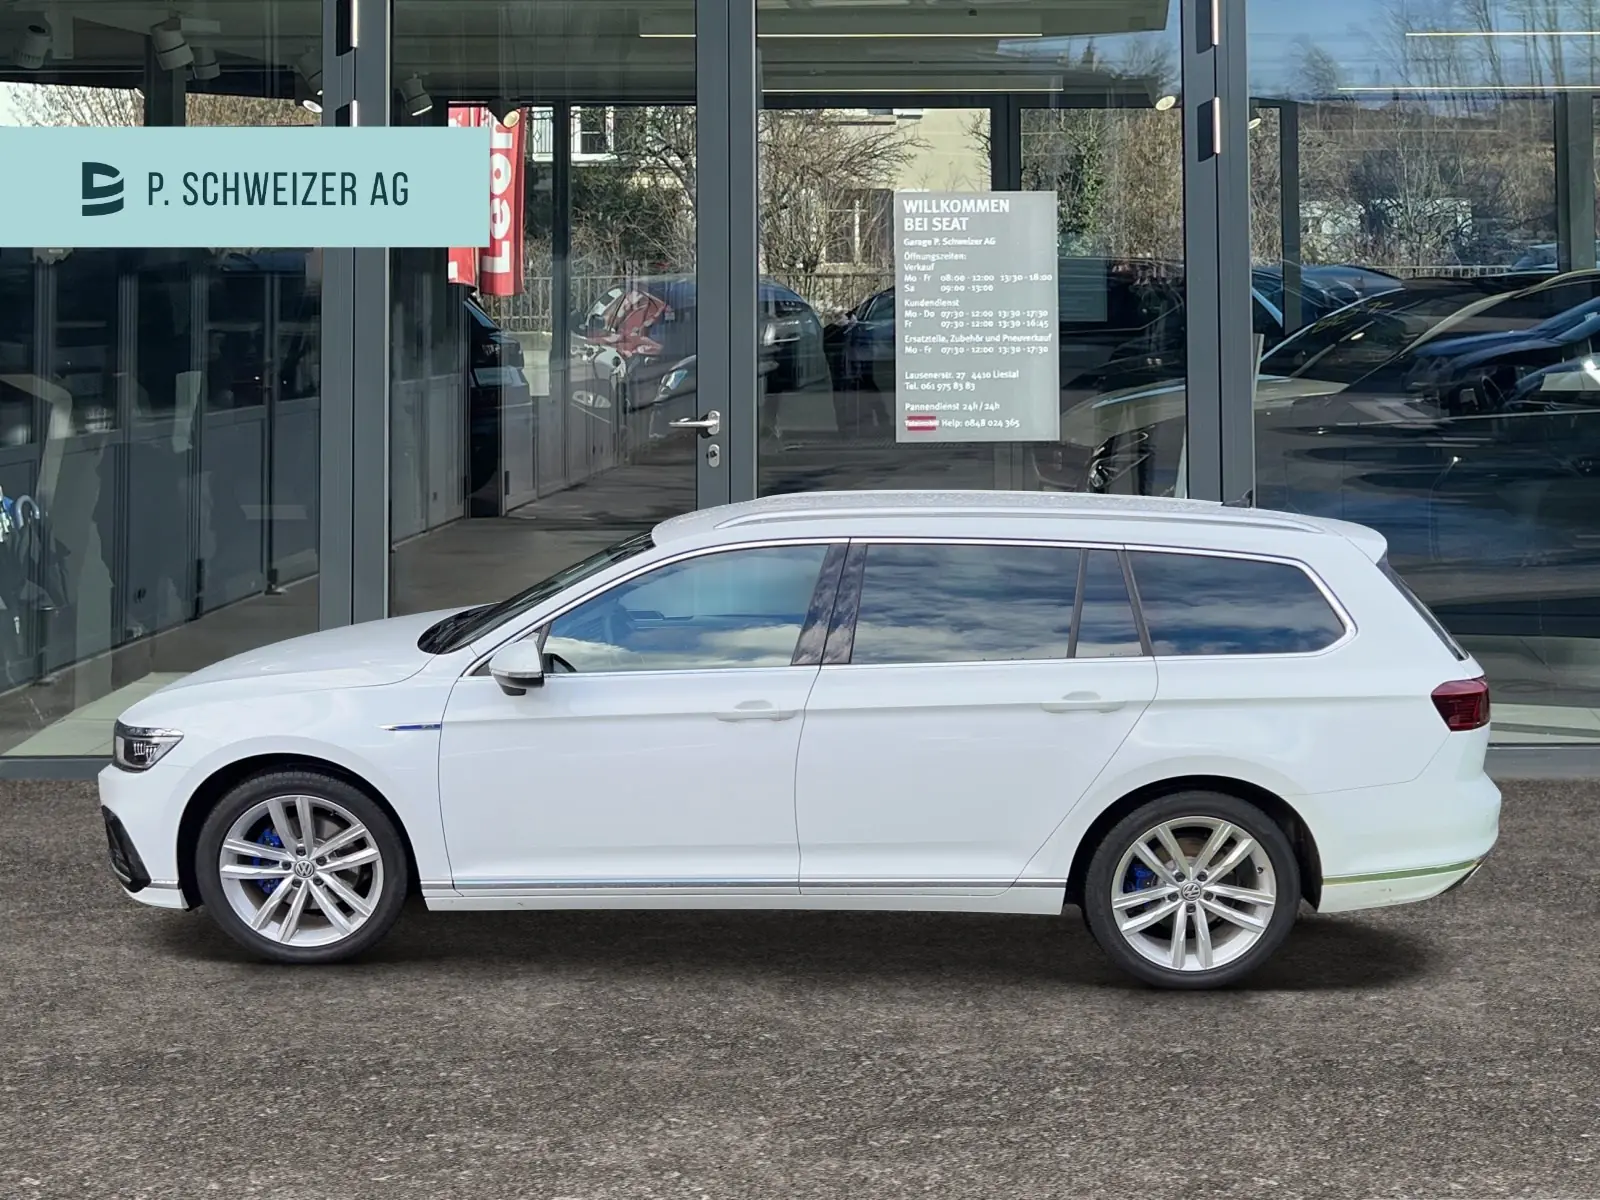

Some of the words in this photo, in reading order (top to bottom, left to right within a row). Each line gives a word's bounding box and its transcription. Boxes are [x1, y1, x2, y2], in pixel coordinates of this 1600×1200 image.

[903, 200, 1010, 213] WILLKOMMEN
[904, 218, 928, 231] BEI
[932, 217, 969, 231] SEAT
[904, 238, 932, 247] Garage
[984, 237, 996, 245] AG
[904, 263, 935, 271] Verkauf
[904, 310, 917, 318] Mo
[924, 310, 935, 318] Do
[941, 311, 964, 320] 07:30
[1027, 310, 1048, 319] 17:30
[1027, 320, 1049, 328] 16:45
[950, 334, 984, 343] Zubehör
[941, 347, 964, 355] 07:30
[956, 372, 966, 380] 27
[993, 370, 1019, 378] Liestal
[905, 382, 918, 390] Tel.
[921, 382, 935, 390] 061
[937, 383, 951, 392] 975
[953, 382, 963, 391] 83
[965, 382, 976, 391] 83
[905, 402, 959, 411] Pannendienst
[963, 401, 978, 412] 24h
[985, 402, 1000, 411] 24h
[942, 420, 963, 428] Help:
[1005, 420, 1020, 428] 365
